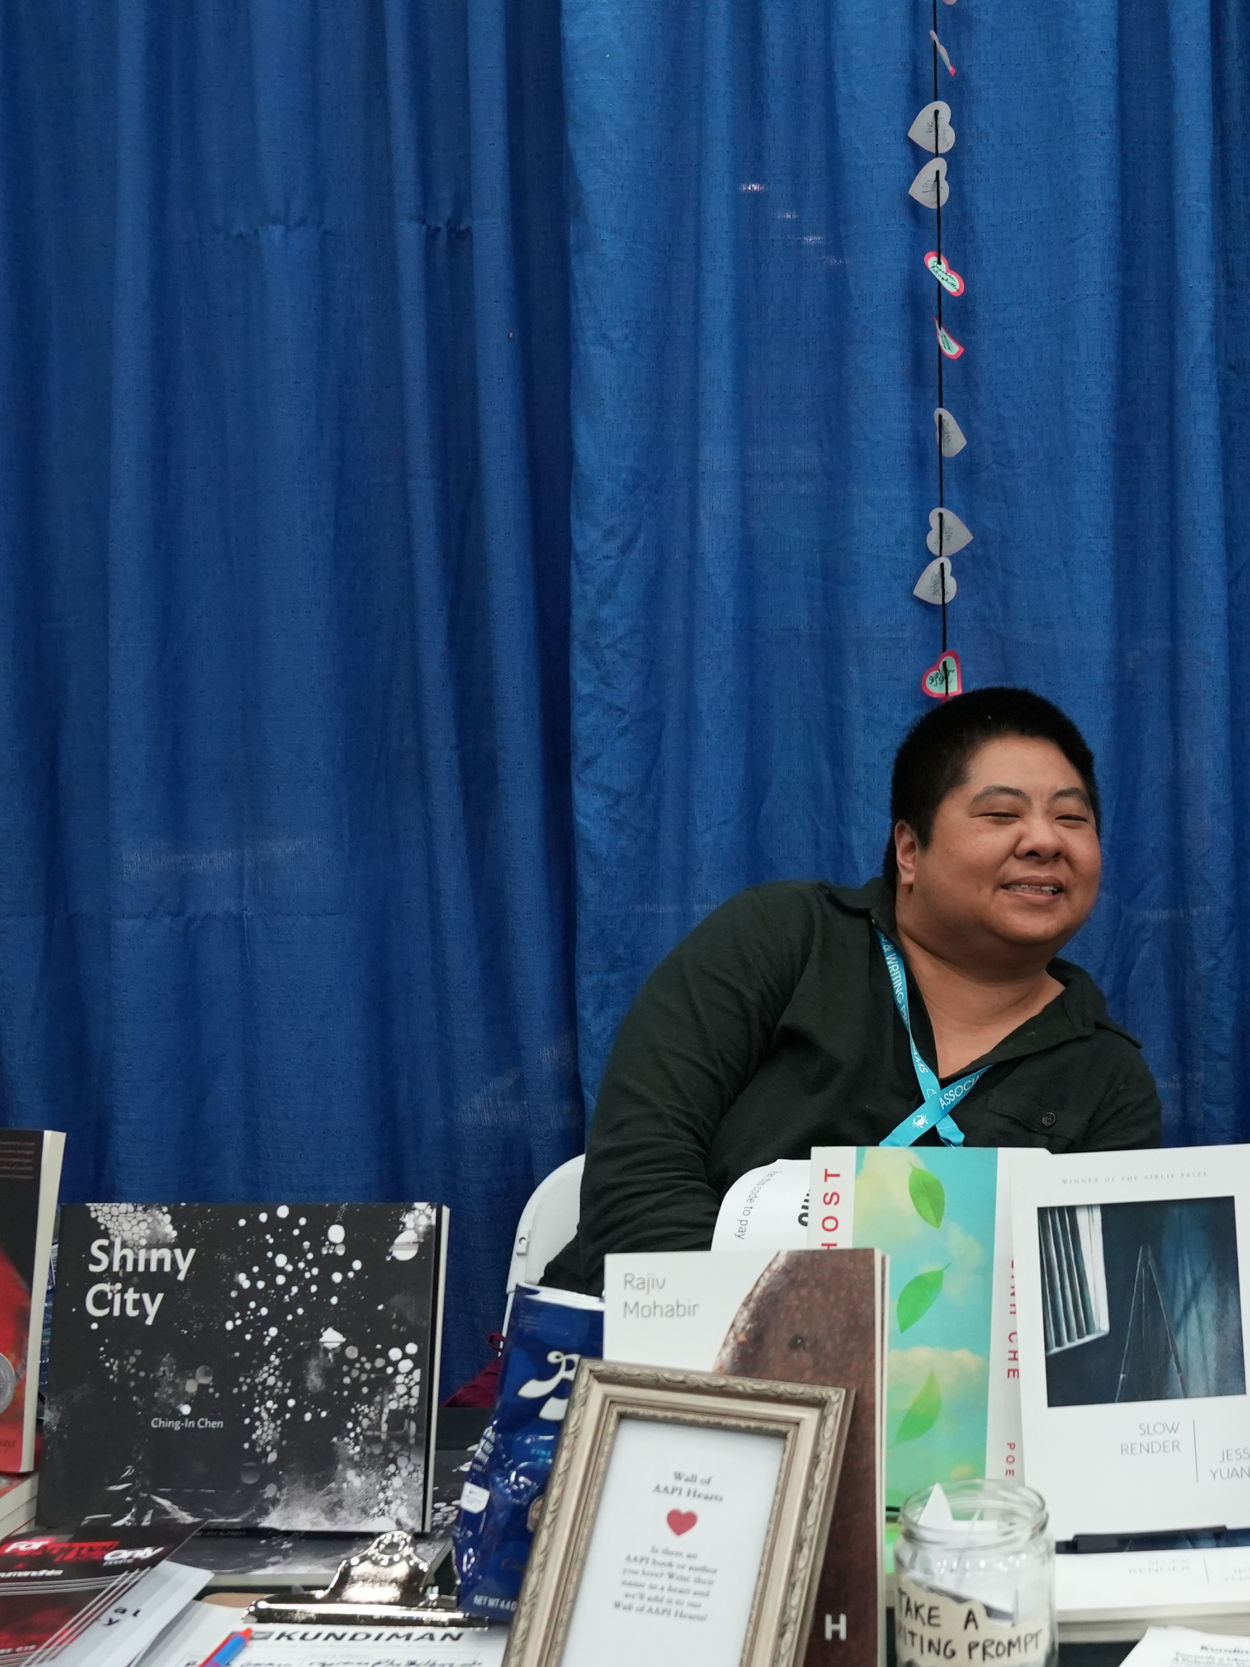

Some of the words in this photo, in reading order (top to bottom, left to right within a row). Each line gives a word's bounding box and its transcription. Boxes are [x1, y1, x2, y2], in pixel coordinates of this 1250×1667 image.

[885, 953, 905, 1004] WRITING
[742, 1206, 754, 1217] to
[734, 1219, 749, 1240] pay
[88, 1238, 196, 1282] Shiny
[623, 1272, 666, 1292] Rajiv
[85, 1283, 164, 1326] City
[623, 1300, 699, 1319] Mohabir
[151, 1416, 194, 1430] Ching-In
[196, 1416, 224, 1430] Chen
[1138, 1420, 1181, 1436] SLOW
[1120, 1439, 1182, 1456] RENDER
[1219, 1447, 1250, 1463] JESS
[673, 1471, 699, 1483] Wall
[700, 1475, 714, 1486] of
[653, 1484, 684, 1497] AAPI
[686, 1488, 724, 1502] Hearts
[625, 1554, 650, 1565] AAPI
[613, 1601, 634, 1612] Wall
[647, 1605, 672, 1617] AAPI
[897, 1588, 941, 1627] TAKE
[963, 1608, 979, 1630] A
[275, 1631, 465, 1642] KUNDIMAN
[968, 1629, 1043, 1661] PROMPT
